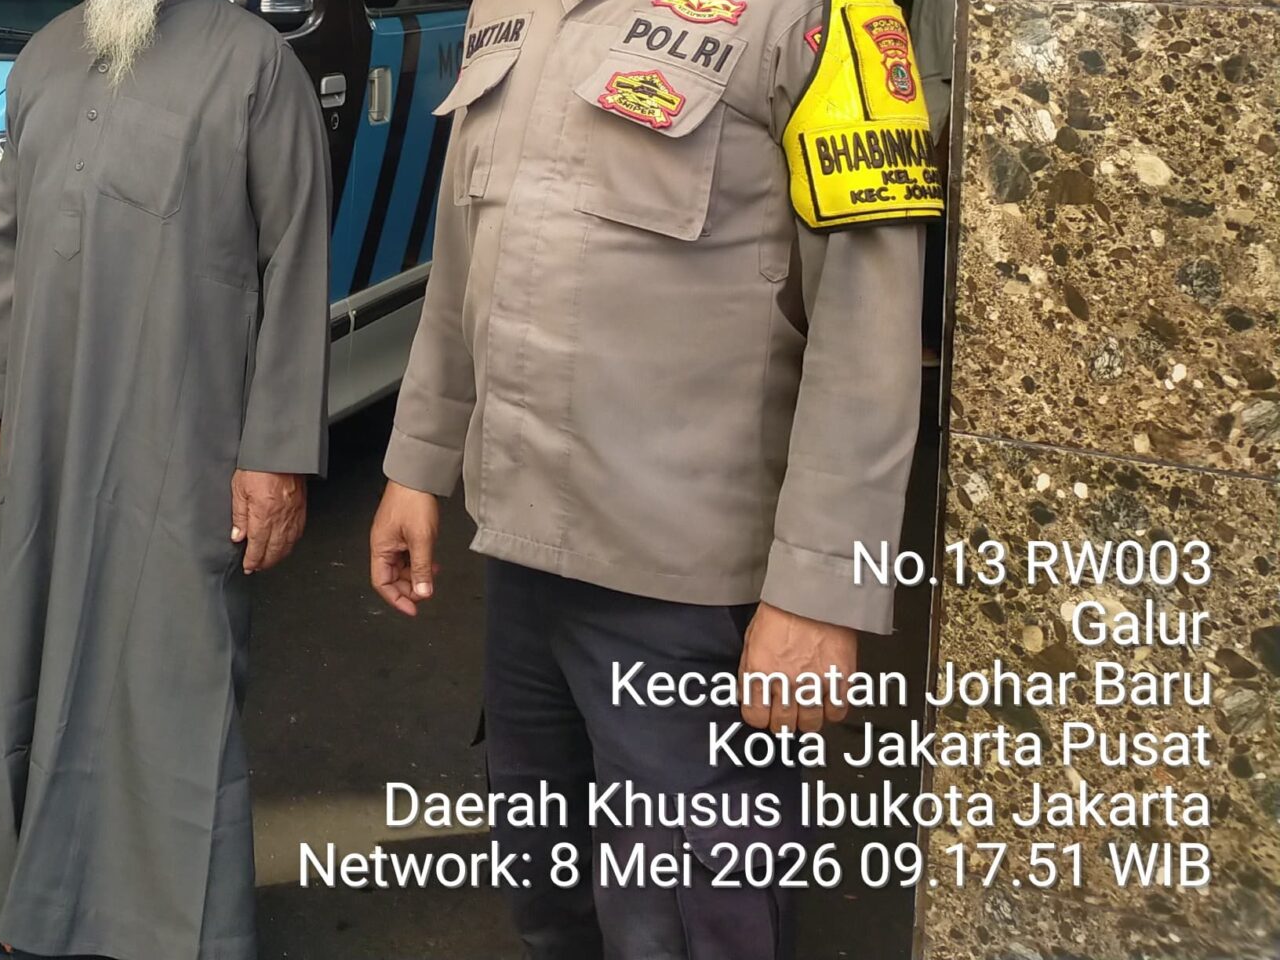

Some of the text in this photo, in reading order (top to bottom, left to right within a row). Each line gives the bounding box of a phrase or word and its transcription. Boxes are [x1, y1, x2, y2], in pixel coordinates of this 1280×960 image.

[622, 17, 734, 73] POLRI
[617, 96, 656, 116] SNIPER
[881, 169, 918, 185] KEL.
[850, 187, 897, 204] KEC.
